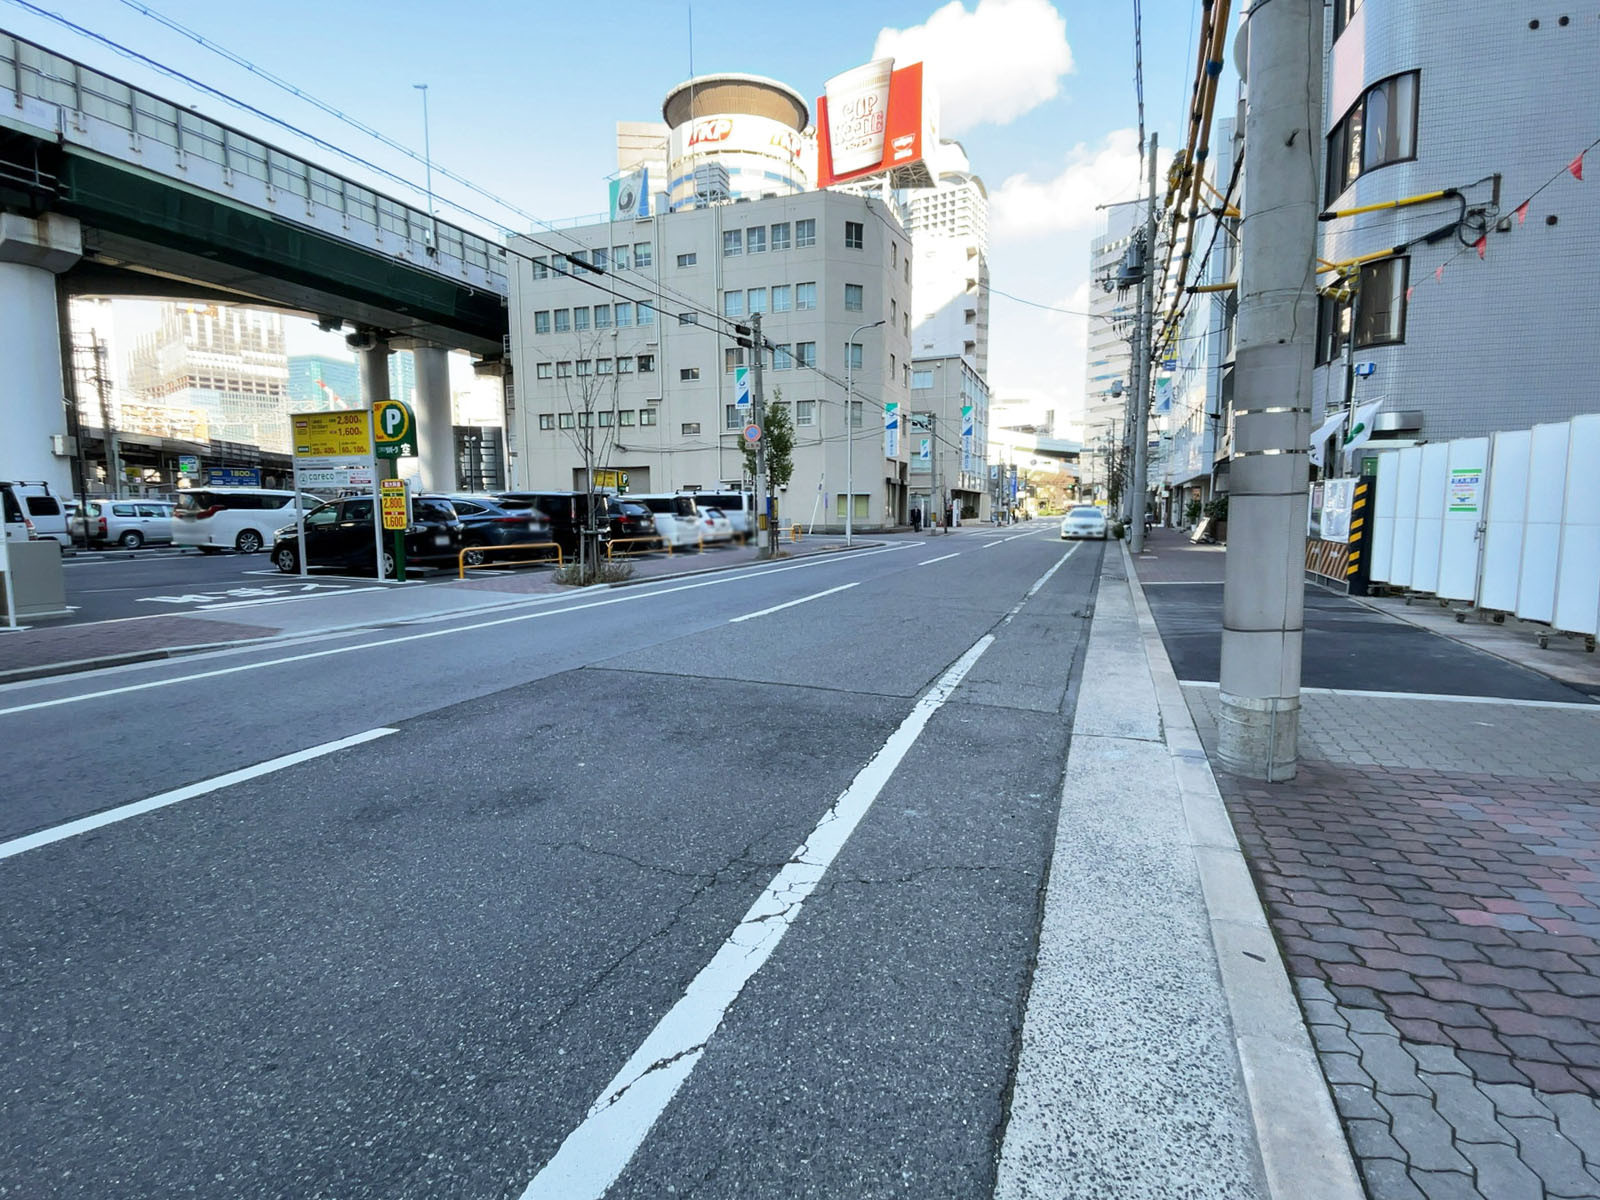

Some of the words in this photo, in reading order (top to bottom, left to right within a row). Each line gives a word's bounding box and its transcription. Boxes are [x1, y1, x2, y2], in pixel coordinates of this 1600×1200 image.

[843, 95, 878, 120] CUP
[688, 119, 734, 147] TKP
[385, 408, 401, 435] P
[400, 442, 412, 457] 空
[308, 472, 335, 481] careco
